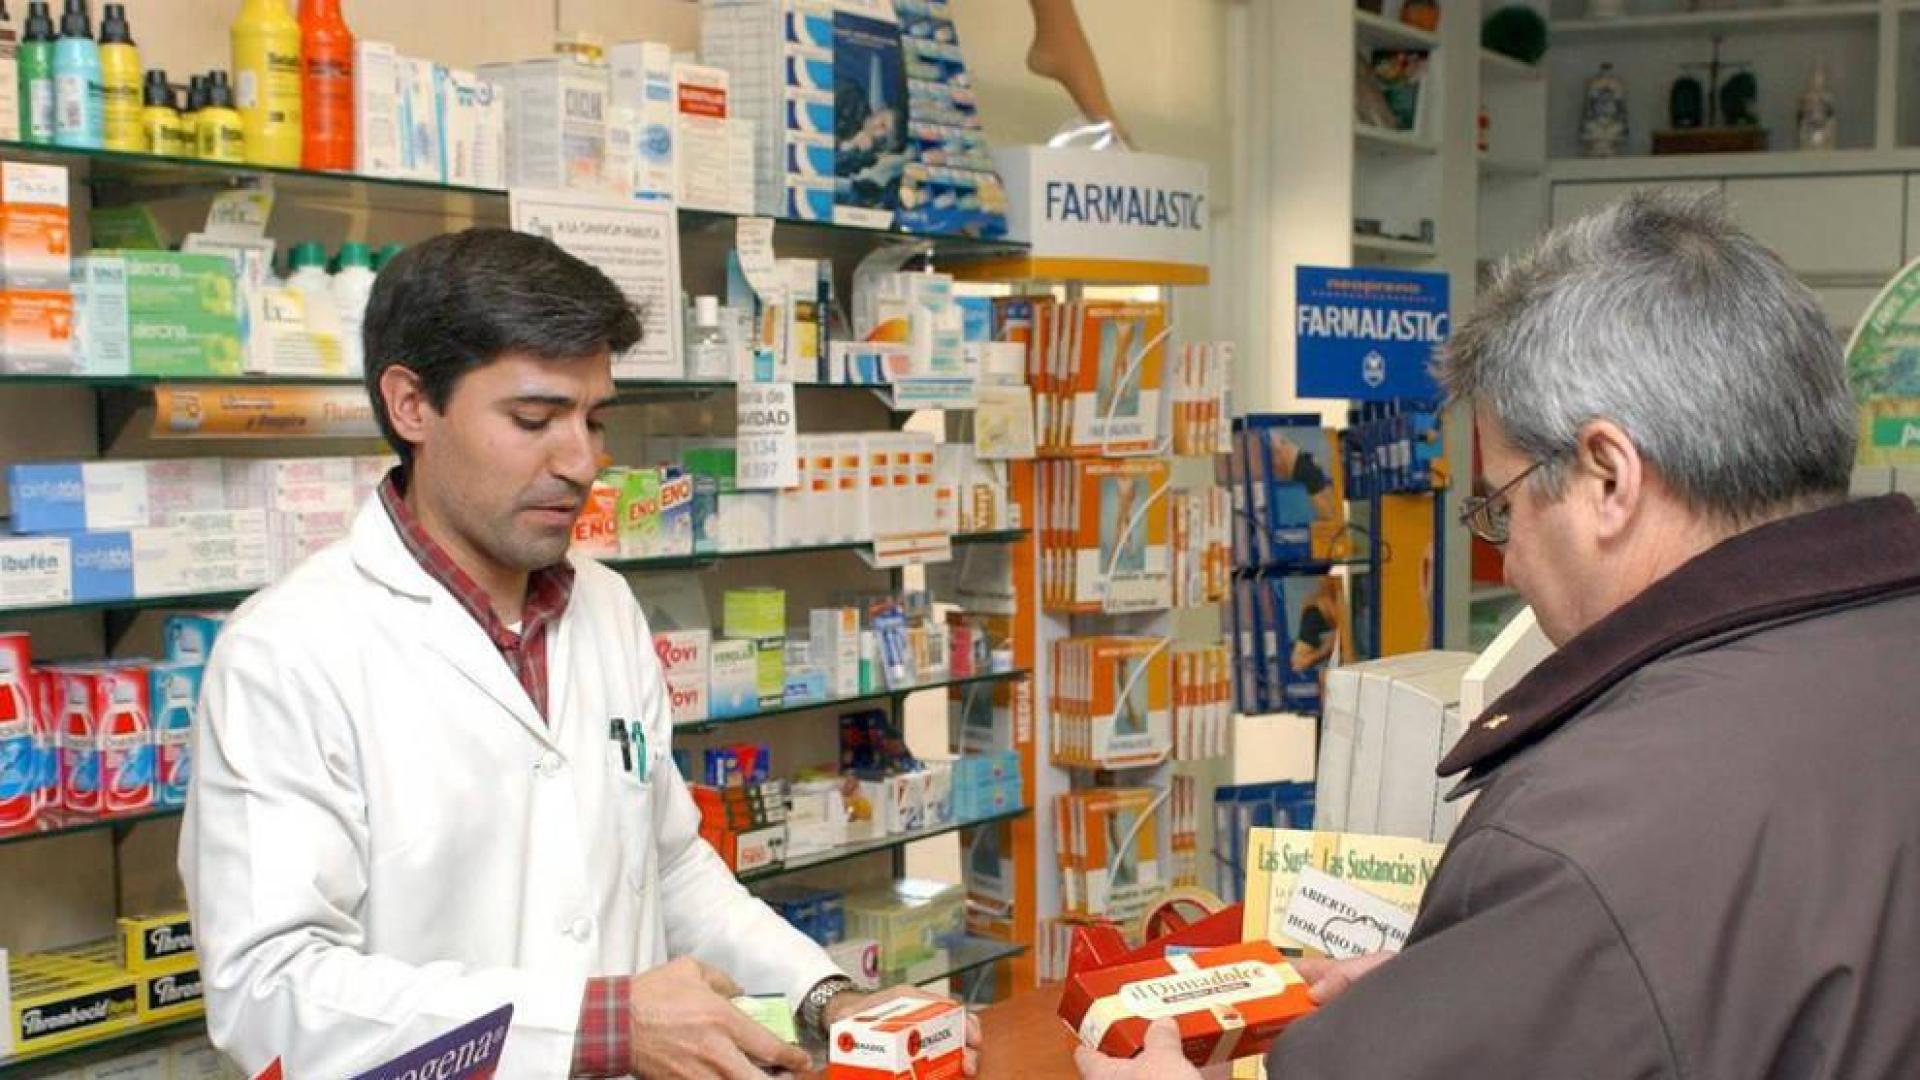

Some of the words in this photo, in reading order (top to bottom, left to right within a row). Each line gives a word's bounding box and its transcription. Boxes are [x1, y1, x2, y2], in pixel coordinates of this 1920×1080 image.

[1046, 181, 1204, 230] FARMALASTIC
[1327, 279, 1422, 295] neopreno
[1298, 304, 1449, 342] FARMALASTIC
[660, 480, 691, 506] ENO
[629, 500, 657, 521] ENO
[575, 519, 617, 540] ENO
[1321, 848, 1345, 878] Las
[1349, 850, 1415, 885] Sustancias
[1302, 885, 1357, 918] ABIERTO
[1287, 914, 1349, 950] HORARIO
